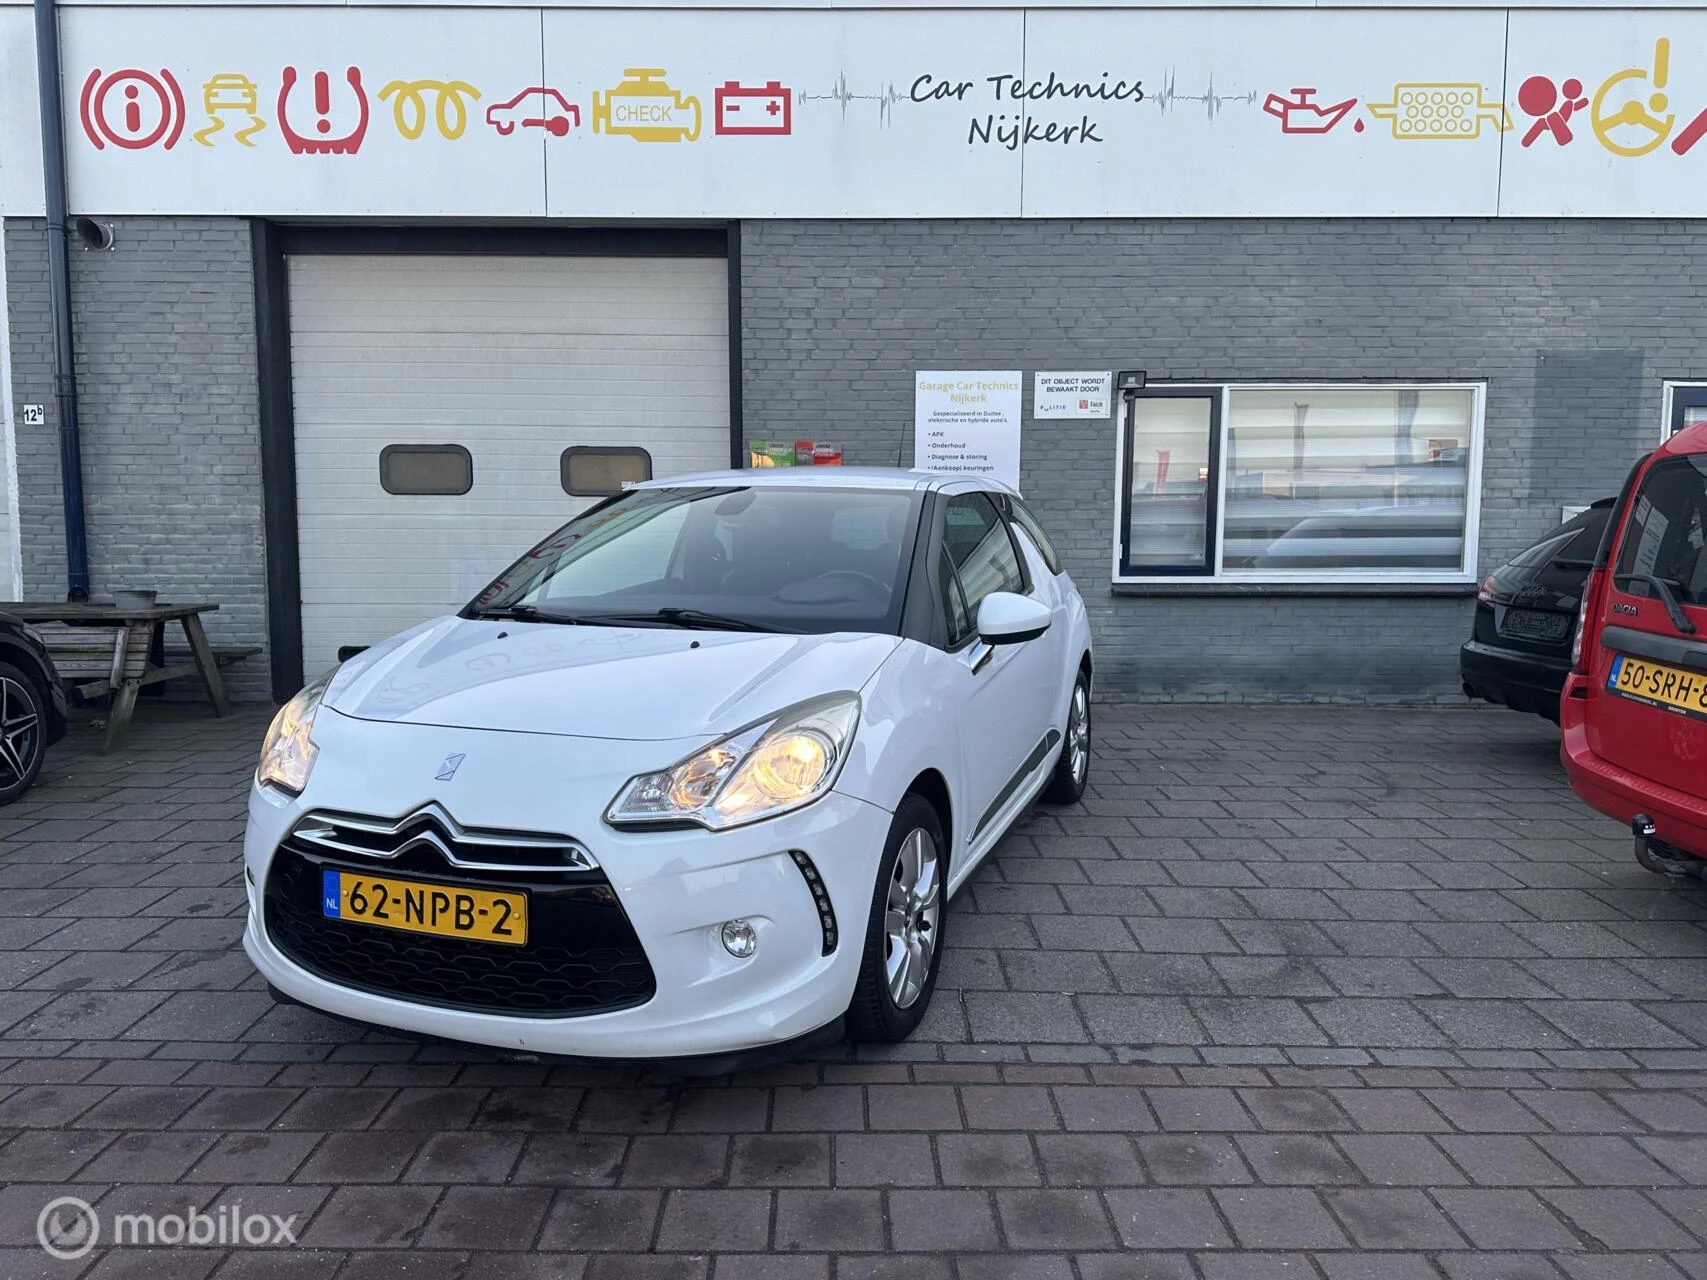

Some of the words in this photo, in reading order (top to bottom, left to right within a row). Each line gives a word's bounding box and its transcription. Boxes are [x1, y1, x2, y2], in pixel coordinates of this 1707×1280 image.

[910, 74, 973, 102] Car
[986, 72, 1144, 102] Technics
[615, 105, 673, 121] CHECK
[968, 114, 1103, 150] Nijkerk
[919, 381, 954, 392] Garage
[957, 381, 973, 390] Car
[976, 381, 1019, 390] Technics
[950, 393, 987, 404] Nijkerk
[326, 898, 339, 910] NL
[349, 881, 513, 936] 62-NPB-2
